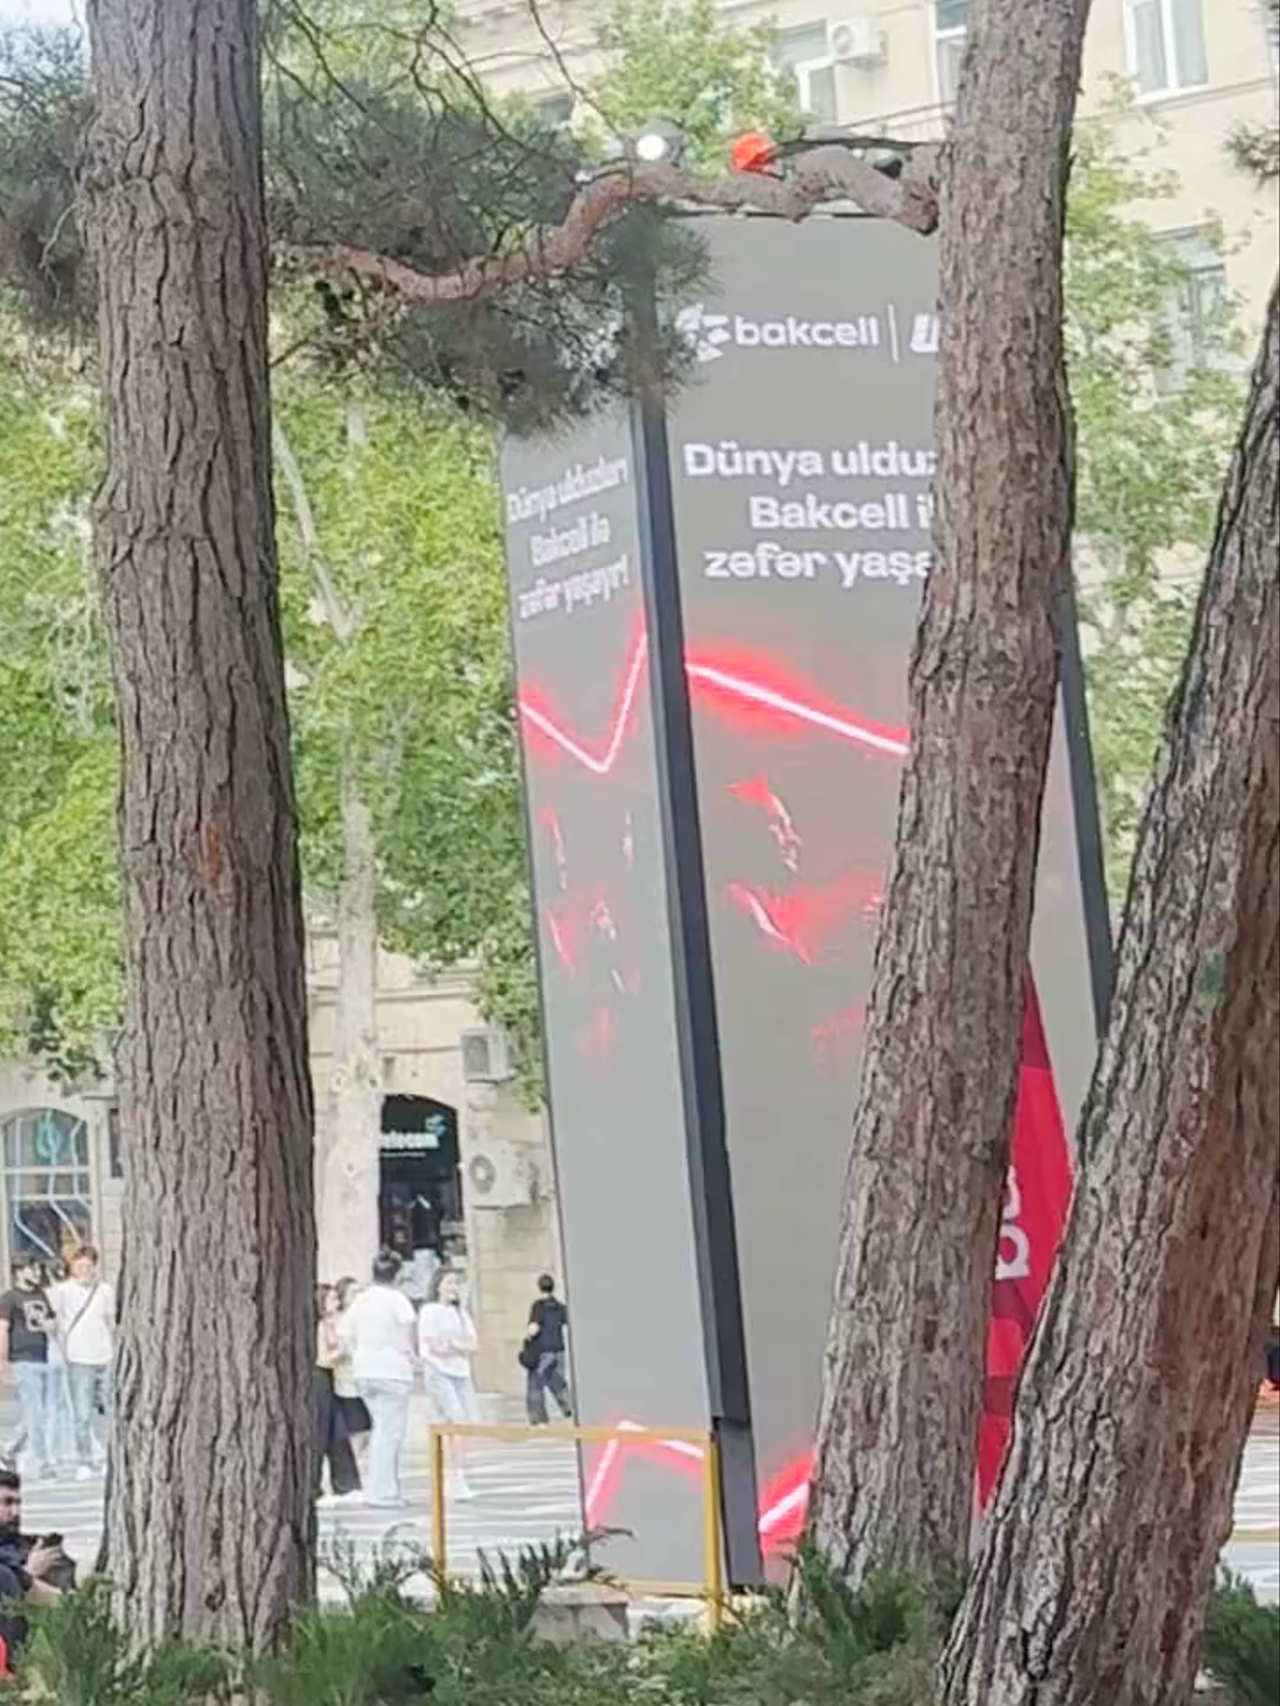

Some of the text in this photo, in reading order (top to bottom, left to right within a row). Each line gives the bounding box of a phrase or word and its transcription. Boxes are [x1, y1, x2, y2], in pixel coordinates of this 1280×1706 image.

[734, 314, 880, 347] bakcell
[683, 440, 825, 487] Dünya
[749, 492, 911, 530] Bakcell
[703, 541, 828, 579] zəfər
